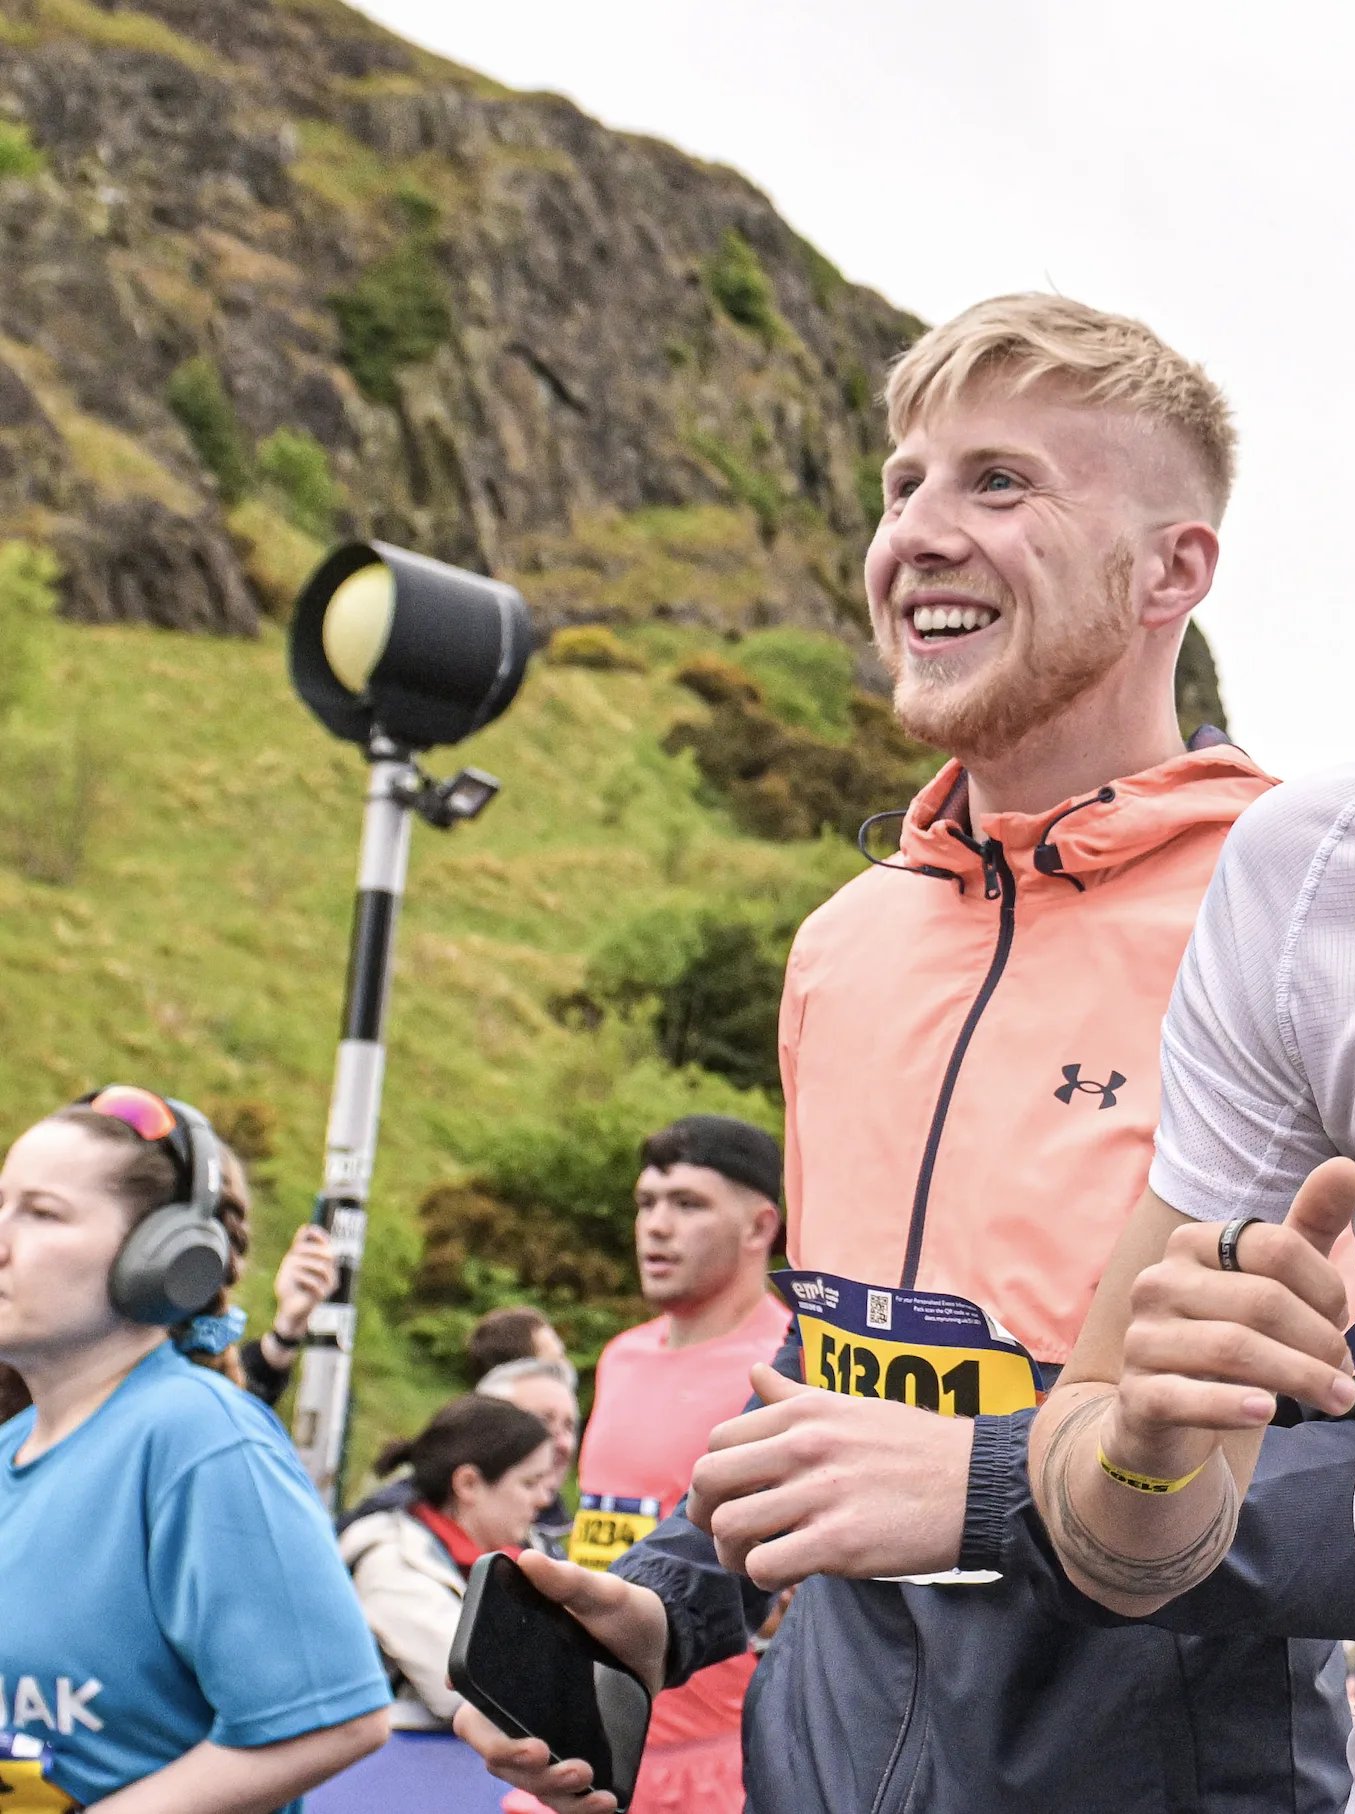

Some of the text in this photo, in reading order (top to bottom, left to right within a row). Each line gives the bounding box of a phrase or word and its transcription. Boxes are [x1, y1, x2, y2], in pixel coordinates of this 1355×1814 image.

[791, 1278, 824, 1299] emf
[820, 1332, 980, 1417] 51301
[0, 1674, 104, 1735] AK
